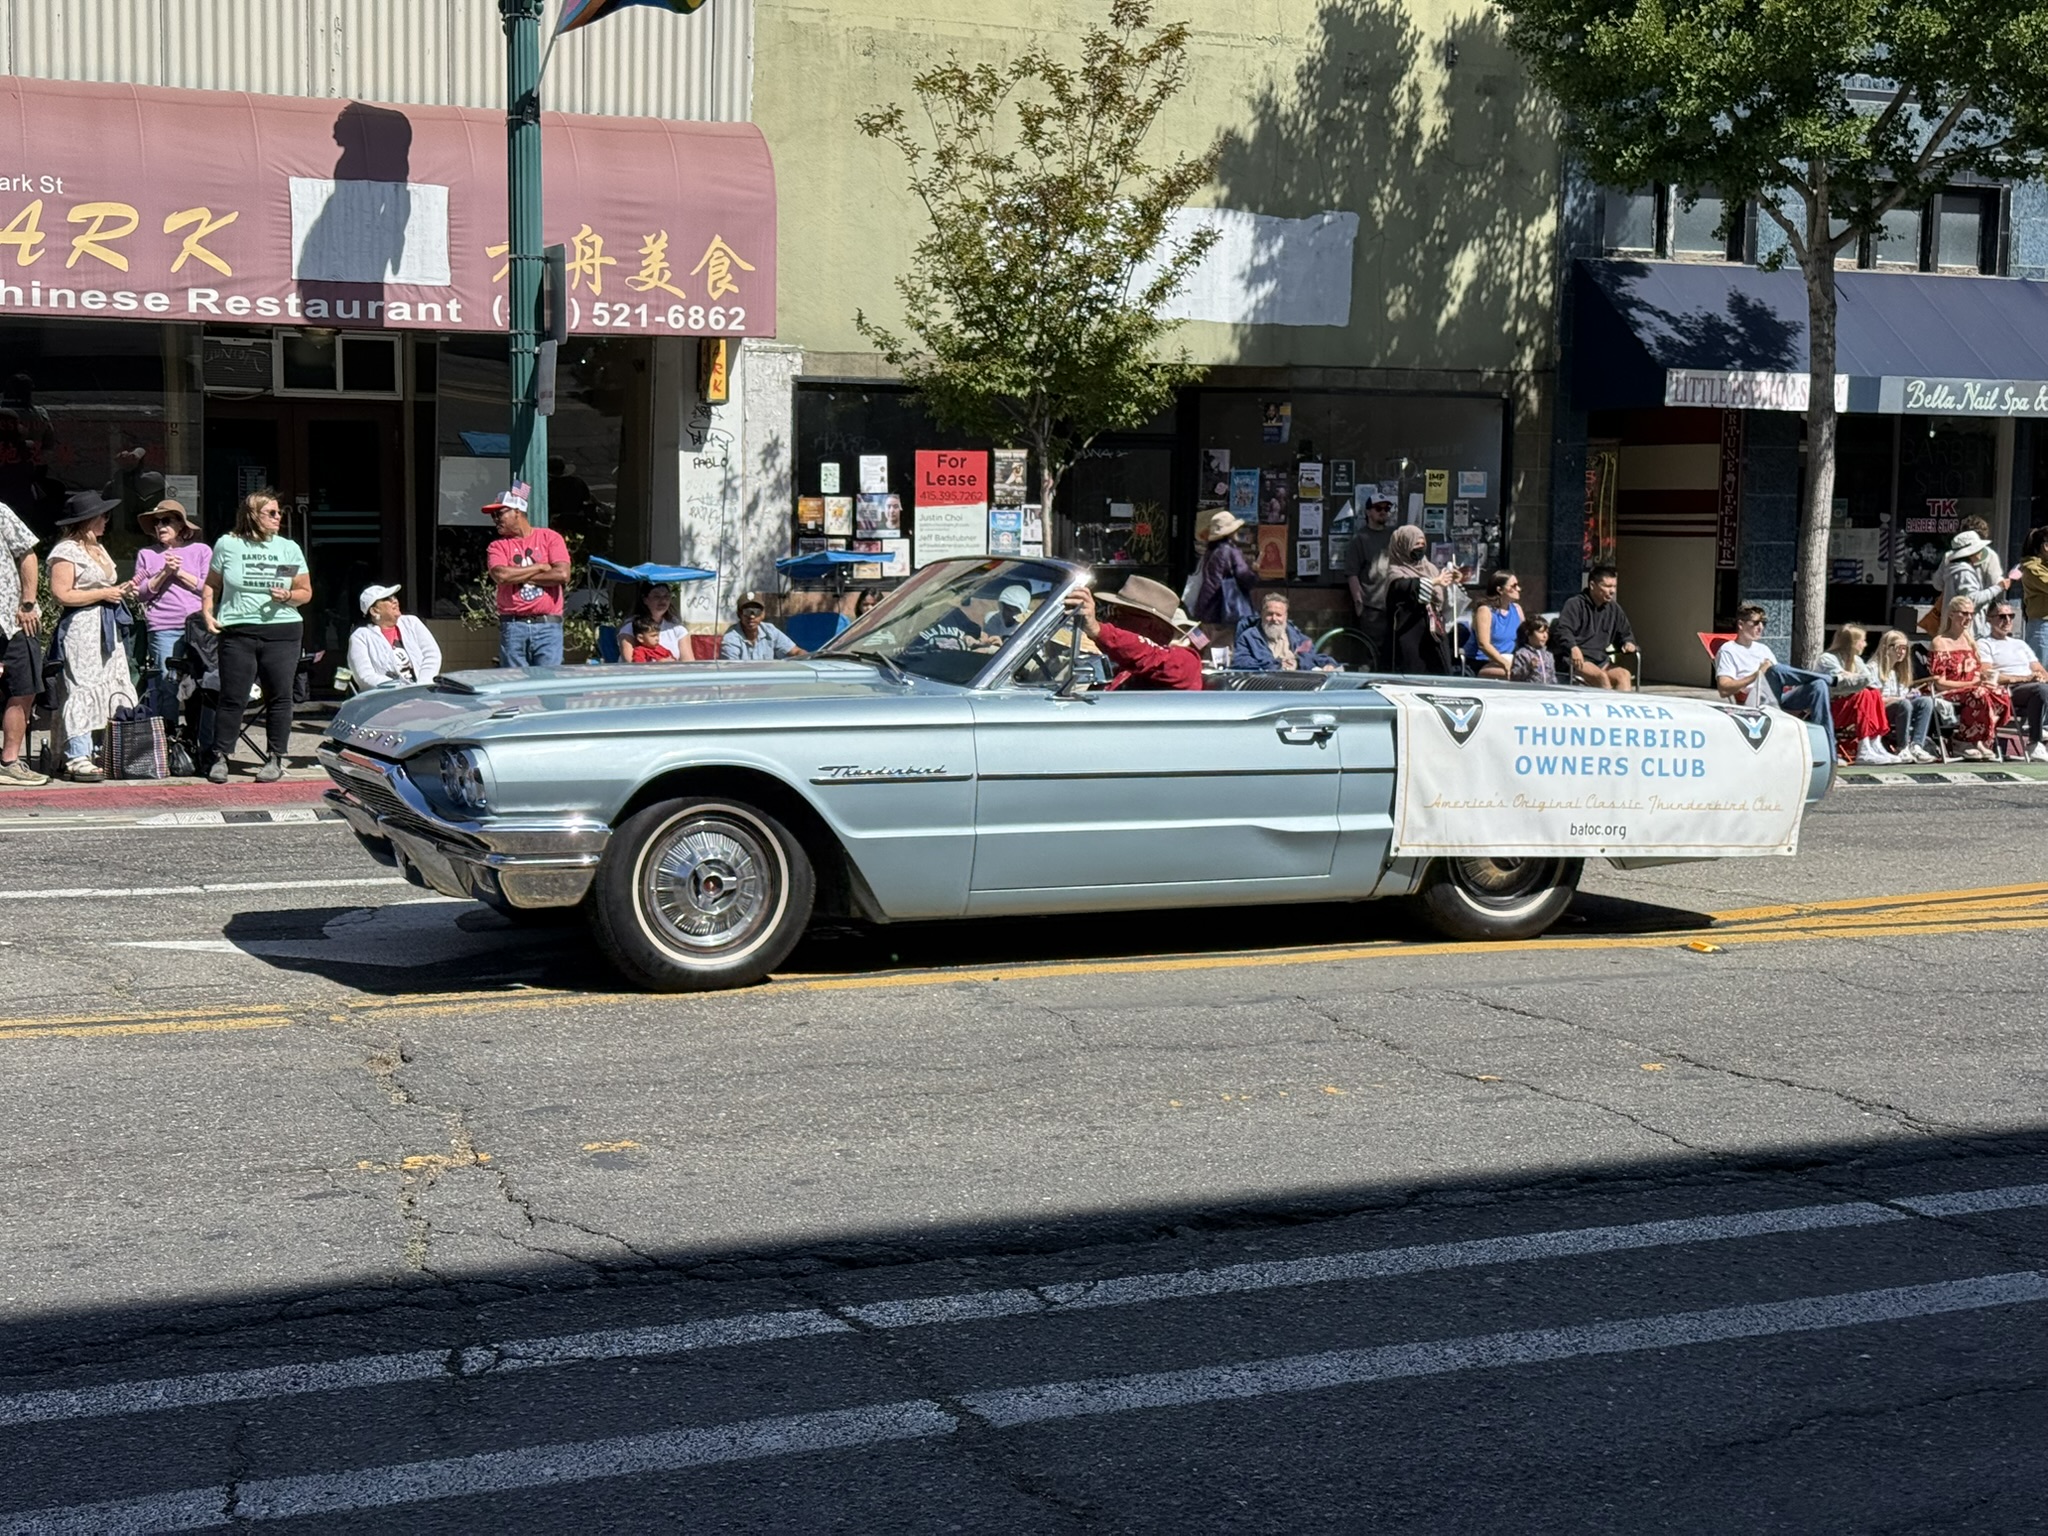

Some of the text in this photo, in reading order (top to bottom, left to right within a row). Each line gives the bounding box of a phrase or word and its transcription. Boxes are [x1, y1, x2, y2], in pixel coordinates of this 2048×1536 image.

[40, 175, 64, 195] St
[0, 198, 239, 277] ARK
[0, 279, 170, 313] hinese
[188, 287, 462, 322] Restaurant
[591, 301, 746, 331] 521-6862
[1675, 376, 1728, 404] LITTLE
[1906, 379, 1956, 409] Bella
[1956, 381, 2000, 411] Nail
[2000, 386, 2030, 415] Spa
[937, 453, 967, 468] For
[925, 471, 977, 486] Lease
[1428, 473, 1445, 481] IMP
[919, 490, 983, 501] 415.395.7262
[1926, 498, 1958, 517] TK
[919, 513, 963, 522] Justin Choi
[1722, 494, 1735, 559] TELLER
[1905, 517, 1960, 533] BARBER SHOP
[919, 623, 966, 641] OLD NAVY
[1541, 702, 1674, 720] BAY AREA
[1514, 725, 1706, 749] THUNDERBIRD
[818, 765, 948, 777] Thunderbird
[1515, 755, 1706, 778] OWNERS CLUB
[1424, 792, 1507, 810] America's
[1512, 793, 1582, 813] Original
[1584, 793, 1644, 811] Classic
[1648, 795, 1750, 814] Thunderbird
[1569, 821, 1627, 840] batoc.org
